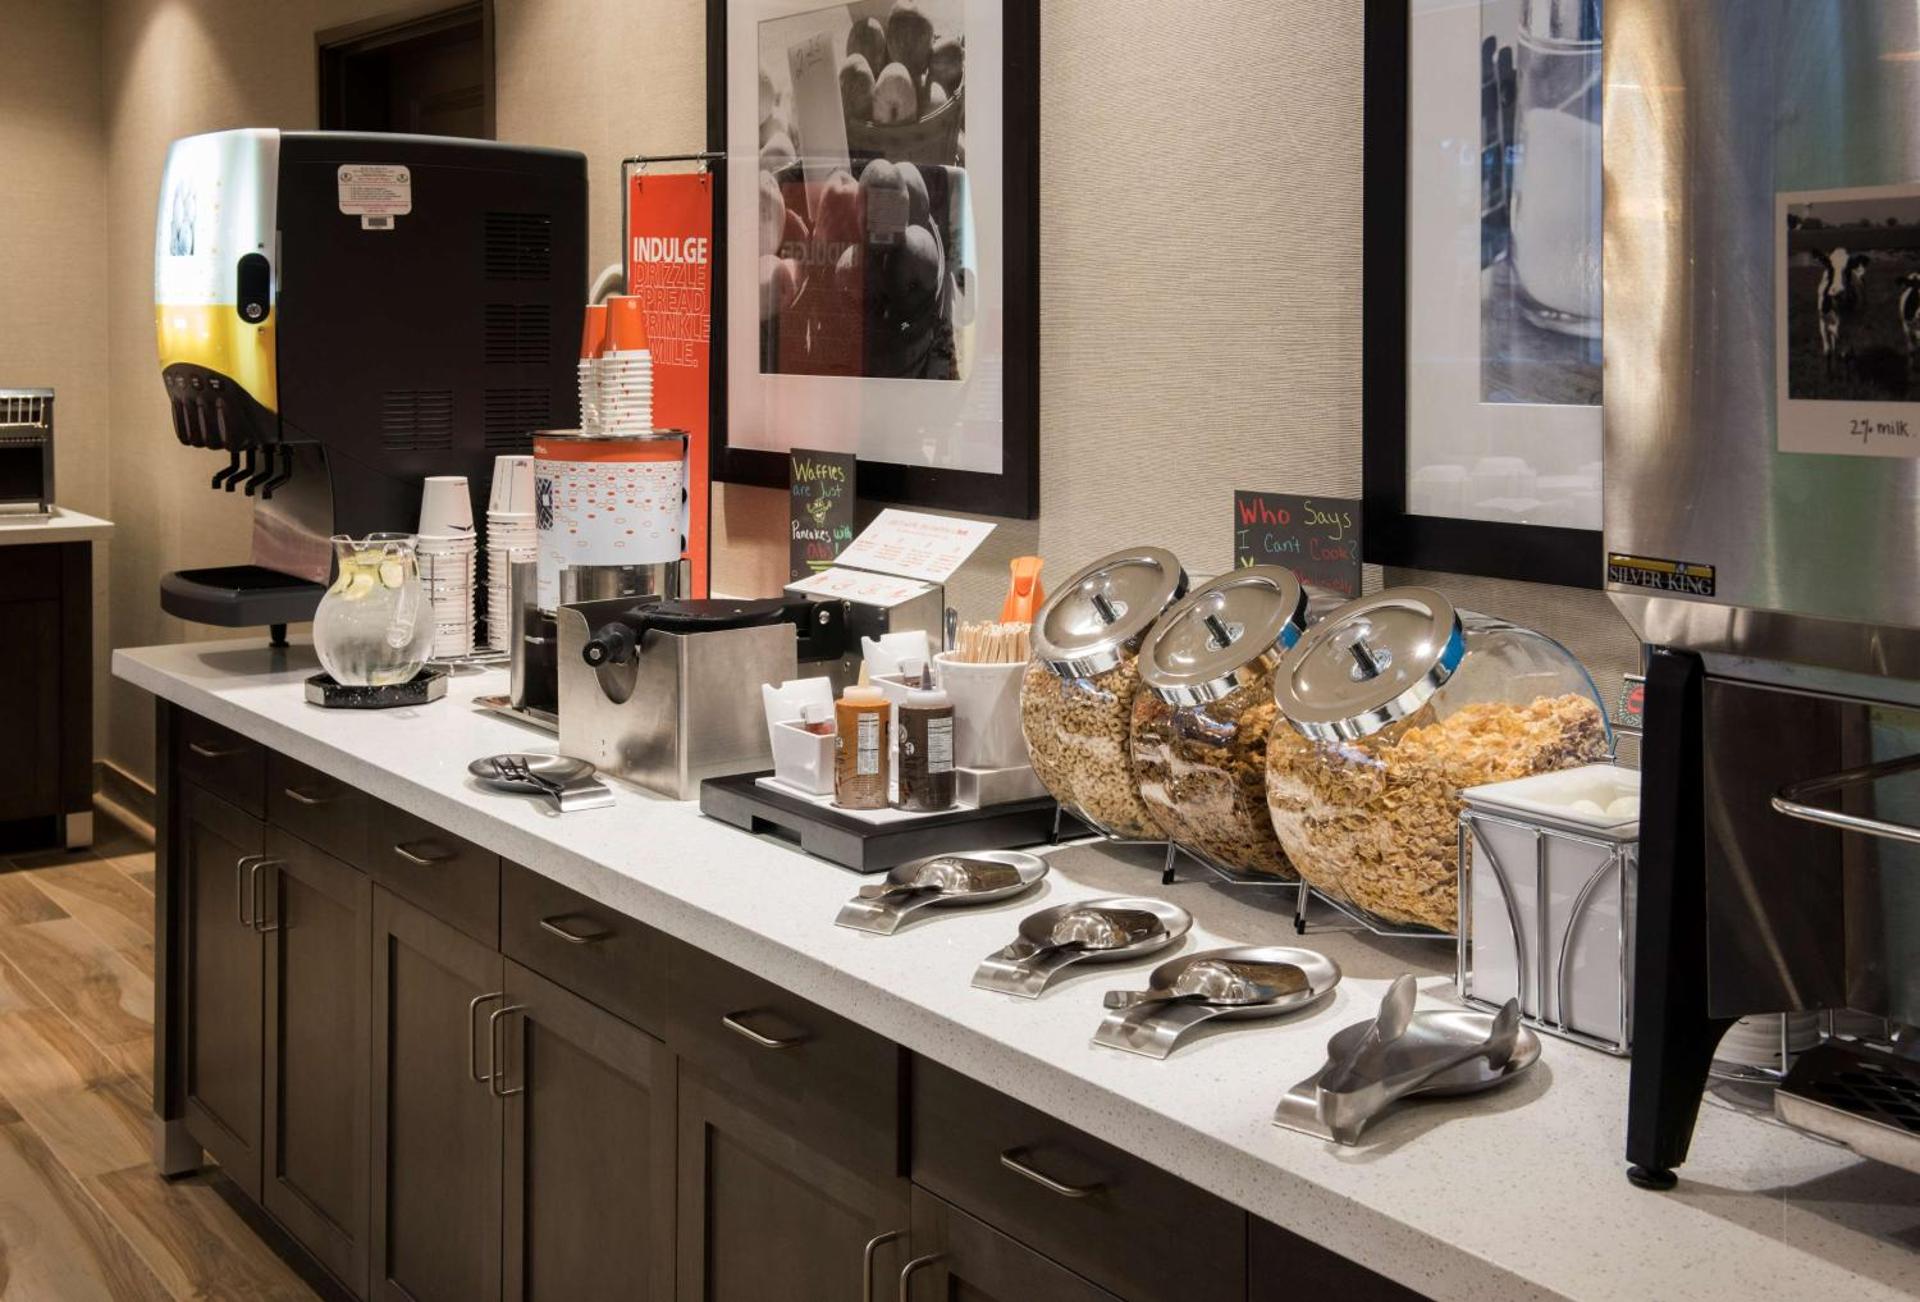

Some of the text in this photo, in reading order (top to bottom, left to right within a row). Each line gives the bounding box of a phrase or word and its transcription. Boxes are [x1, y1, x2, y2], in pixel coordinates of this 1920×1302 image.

[633, 236, 708, 264] INDULGE
[635, 260, 707, 288] DRIZZLE
[644, 312, 710, 340] RINKLE
[648, 336, 698, 367] MILE.
[1877, 420, 1909, 437] milk
[792, 457, 845, 482] Waffles
[792, 520, 832, 543] Pancakes
[1239, 498, 1352, 540] Who Says
[1609, 566, 1713, 595] SILVER KING
